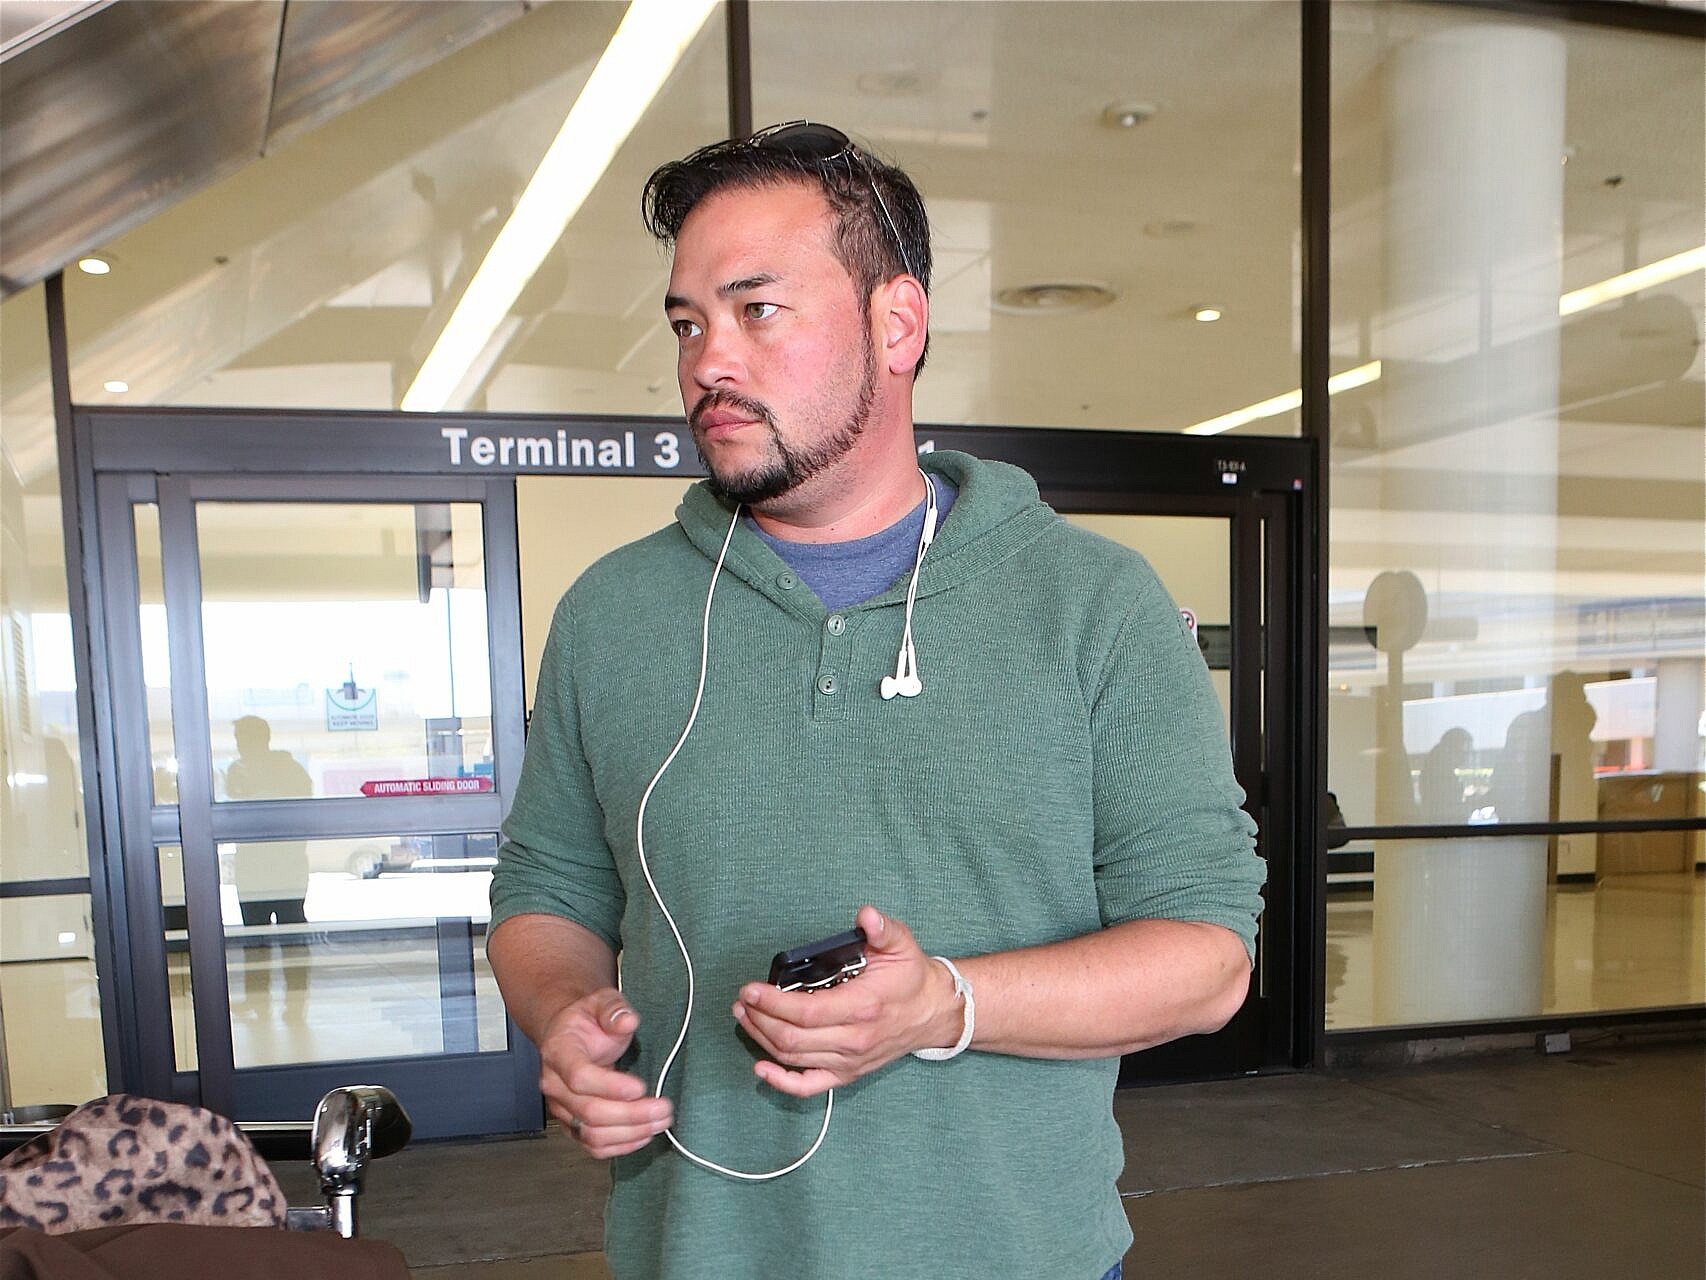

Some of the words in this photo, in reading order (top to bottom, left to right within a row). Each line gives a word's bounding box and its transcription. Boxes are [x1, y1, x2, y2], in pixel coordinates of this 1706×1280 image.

[441, 427, 635, 468] Terminal
[653, 431, 680, 468] 3
[374, 783, 421, 793] AUTOMATIC
[423, 781, 456, 792] SLIDING
[457, 780, 480, 790] DOOR
